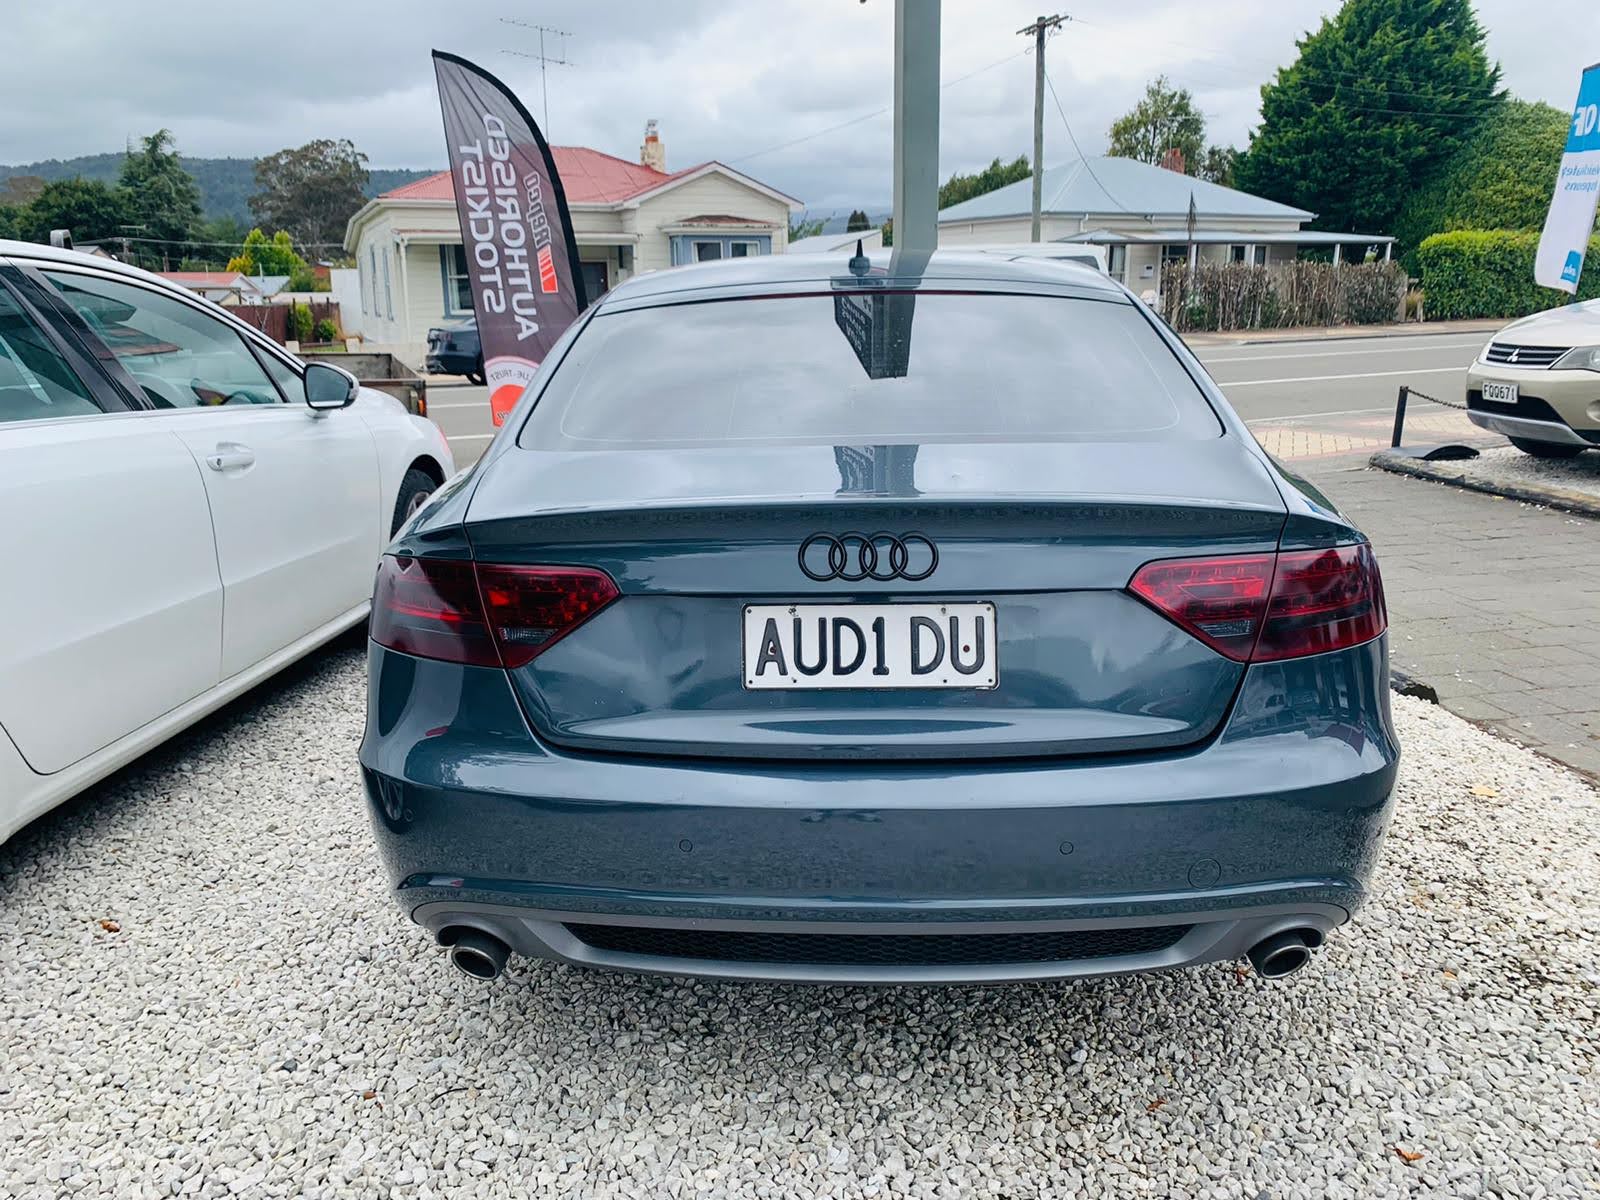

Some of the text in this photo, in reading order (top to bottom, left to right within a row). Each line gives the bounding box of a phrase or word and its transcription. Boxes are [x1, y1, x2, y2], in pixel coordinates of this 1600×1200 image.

[1483, 384, 1515, 401] FQQ671
[755, 616, 986, 676] AUD1 DU
